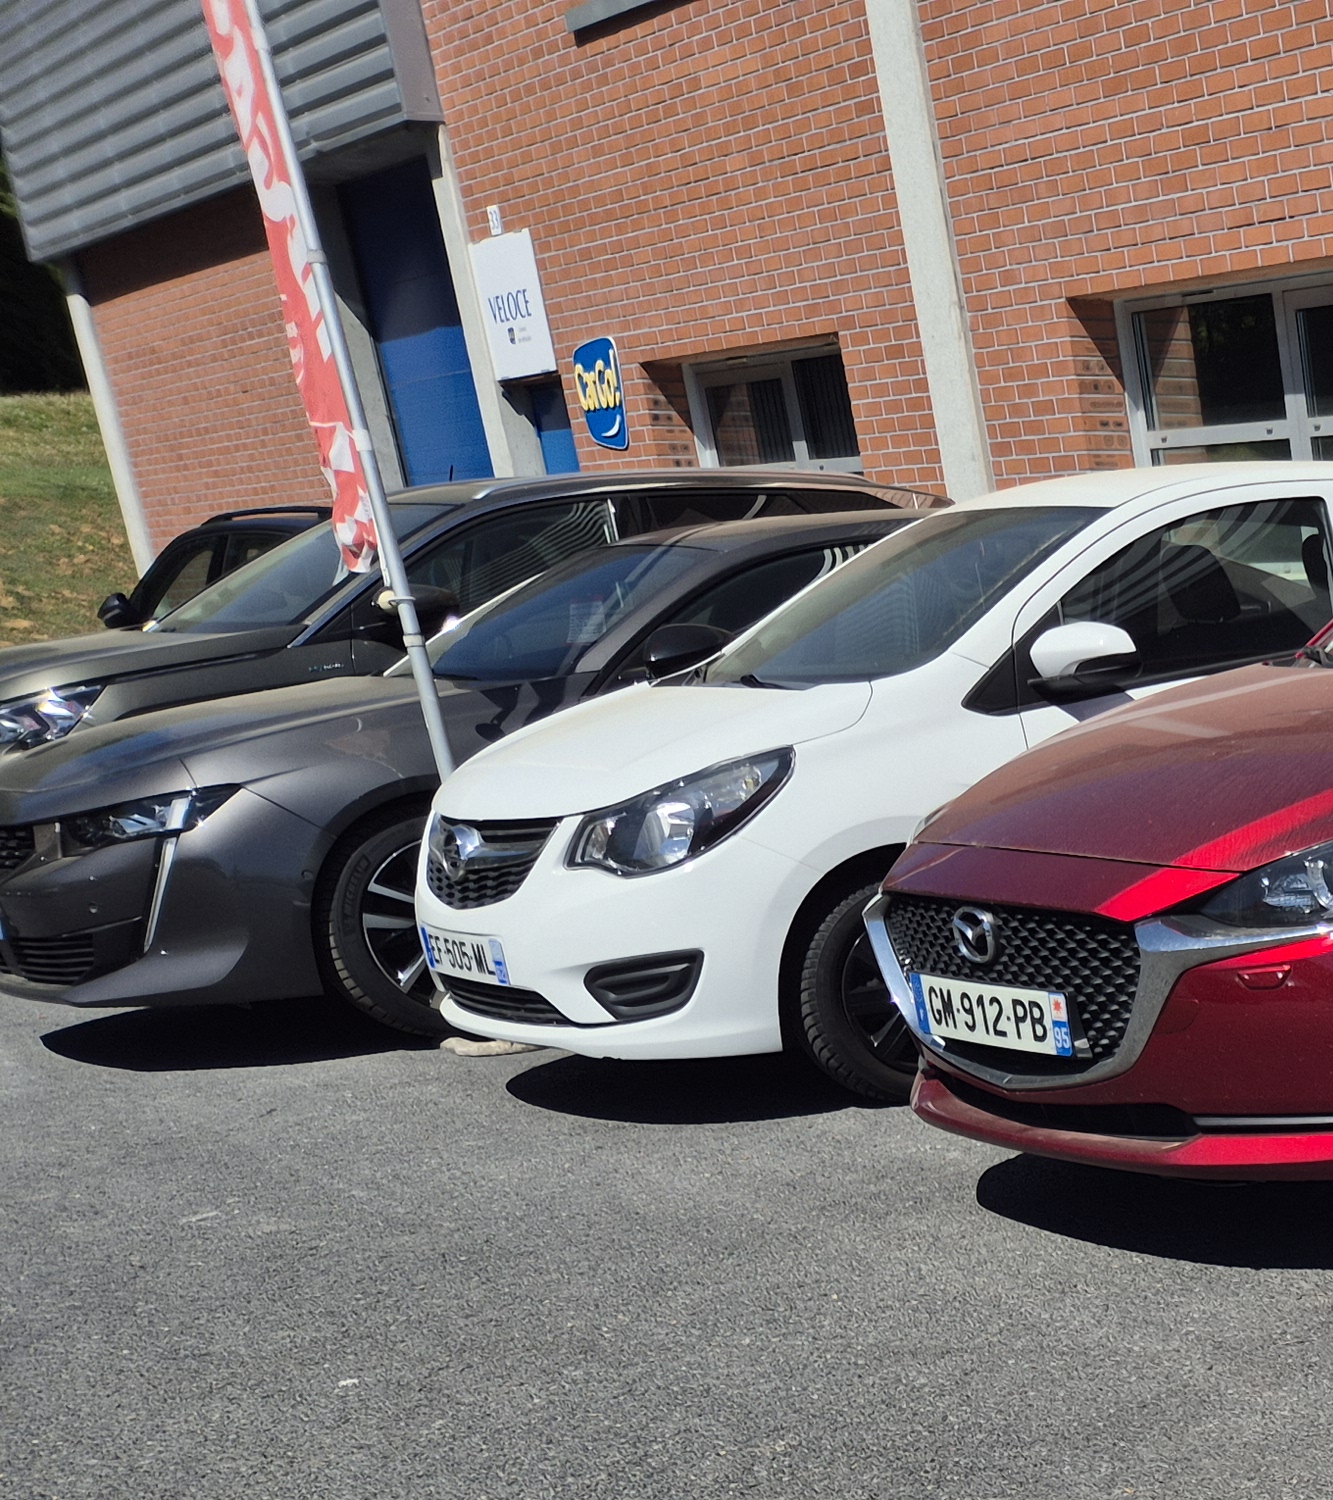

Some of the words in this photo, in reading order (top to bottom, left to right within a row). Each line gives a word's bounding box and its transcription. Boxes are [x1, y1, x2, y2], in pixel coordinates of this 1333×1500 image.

[488, 288, 532, 324] VELOCE
[574, 349, 620, 411] CarGo!
[928, 985, 1048, 1043] GM-912-PB
[1054, 1026, 1070, 1049] 95
